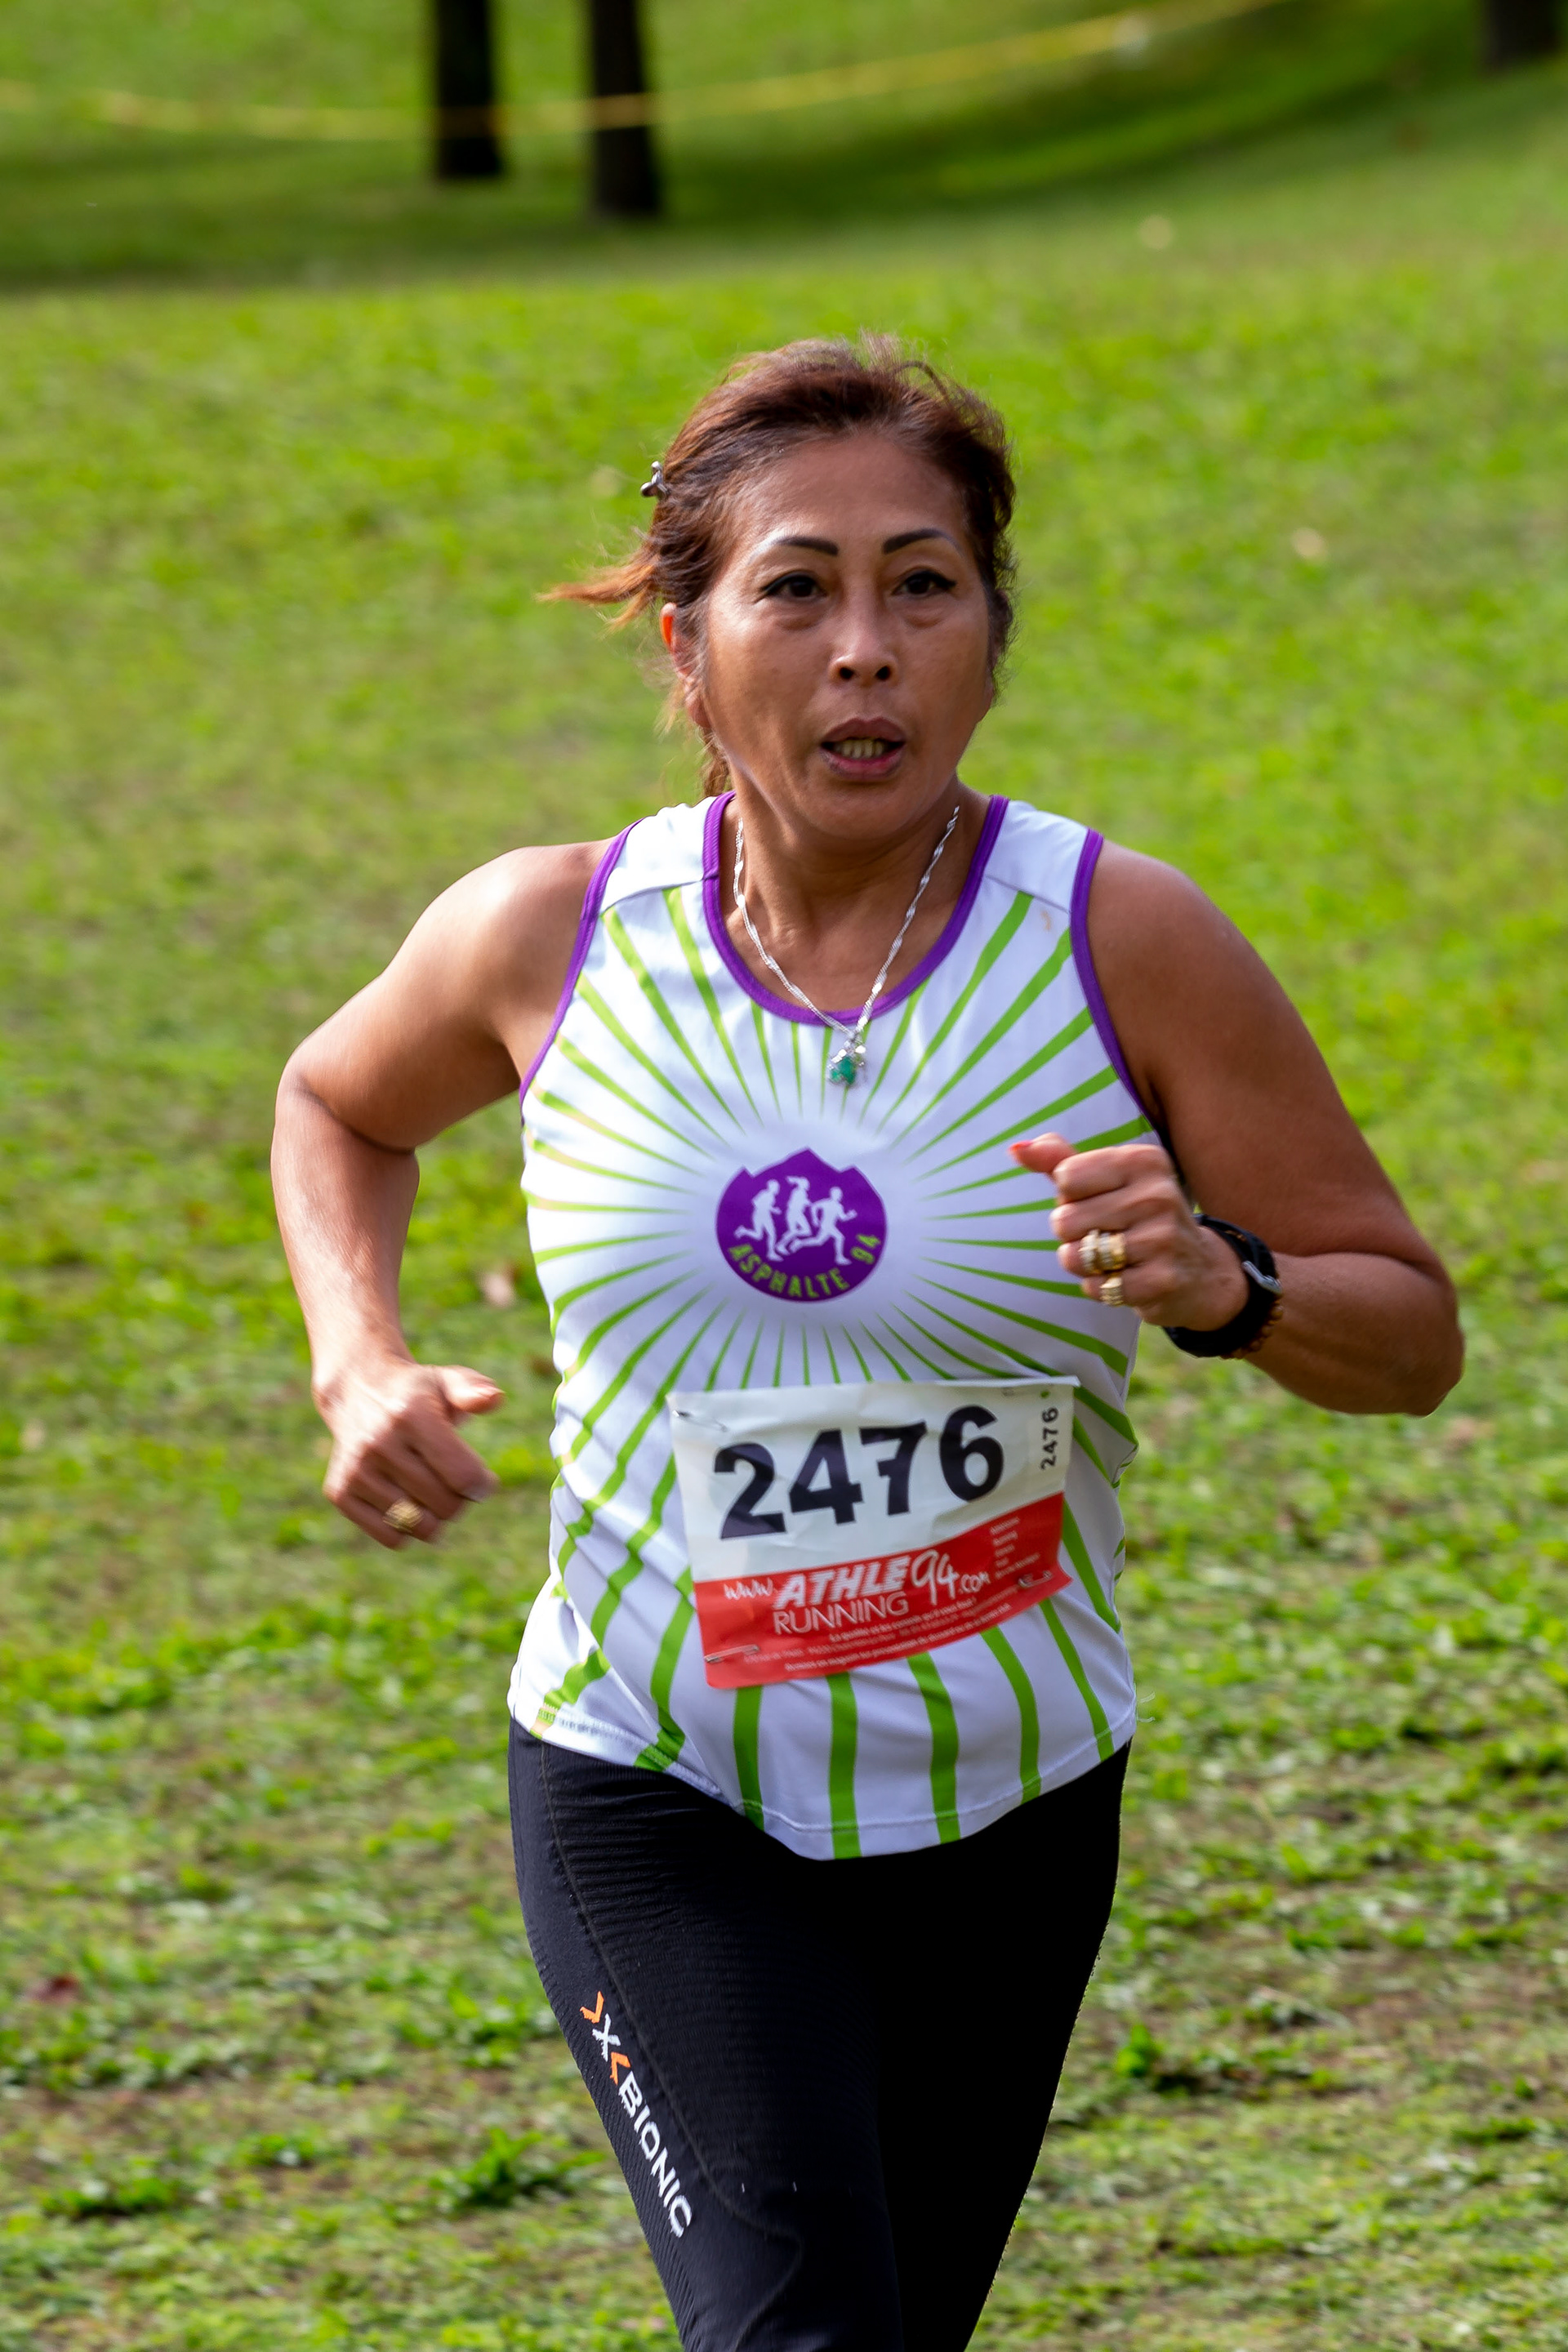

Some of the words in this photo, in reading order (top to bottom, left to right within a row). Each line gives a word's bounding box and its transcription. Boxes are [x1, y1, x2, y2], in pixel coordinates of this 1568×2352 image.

[728, 1244, 851, 1298] ASPHALTE
[1040, 1407, 1058, 1470] 2476
[713, 1405, 1004, 1540] 2476
[773, 1592, 910, 1636] RUNNING
